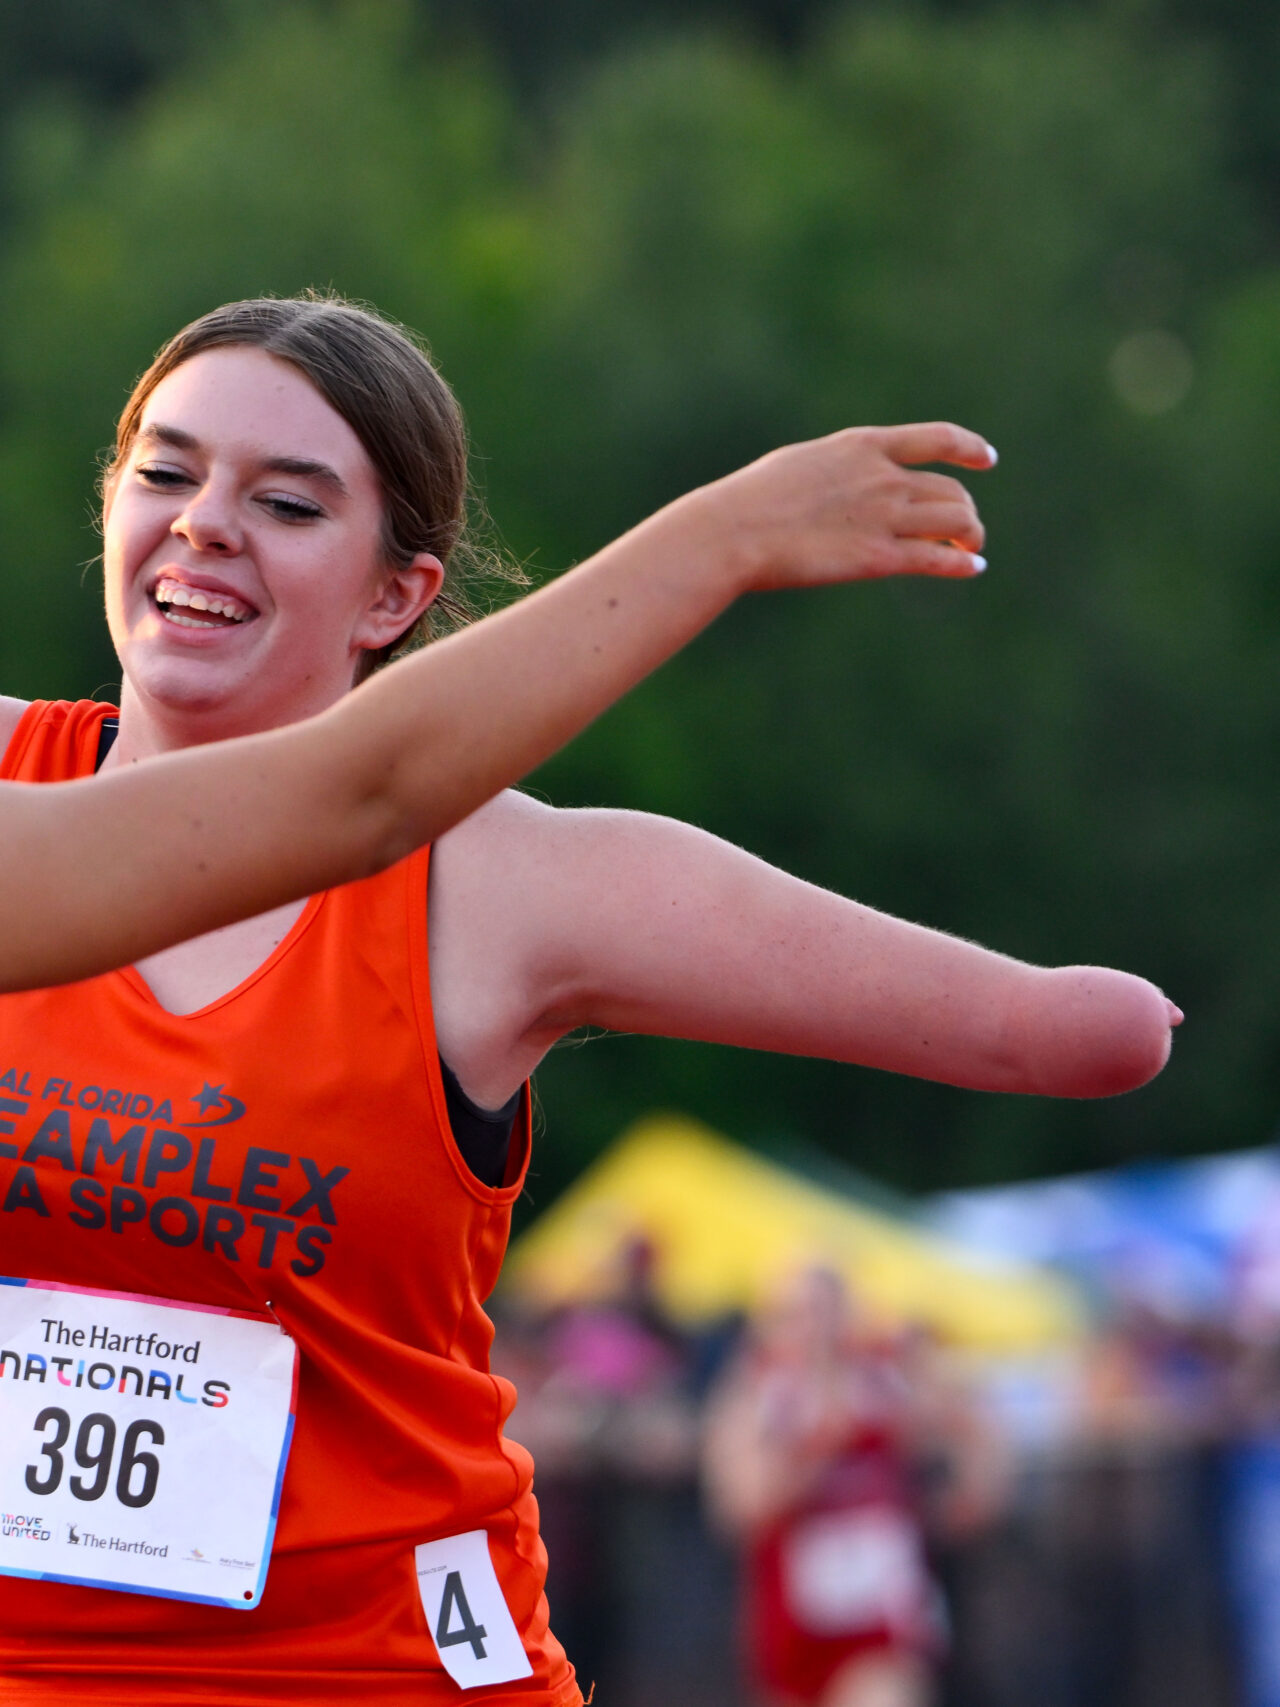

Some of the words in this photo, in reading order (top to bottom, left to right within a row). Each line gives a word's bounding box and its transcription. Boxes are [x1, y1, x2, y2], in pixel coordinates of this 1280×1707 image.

[41, 1077, 173, 1125] FLORIDA
[68, 1177, 333, 1277] SPORTS
[40, 1318, 86, 1347] The
[89, 1325, 201, 1364] Hartford
[24, 1406, 166, 1509] 396
[82, 1533, 107, 1549] The
[109, 1536, 169, 1558] Hartford
[436, 1571, 488, 1660] 4
